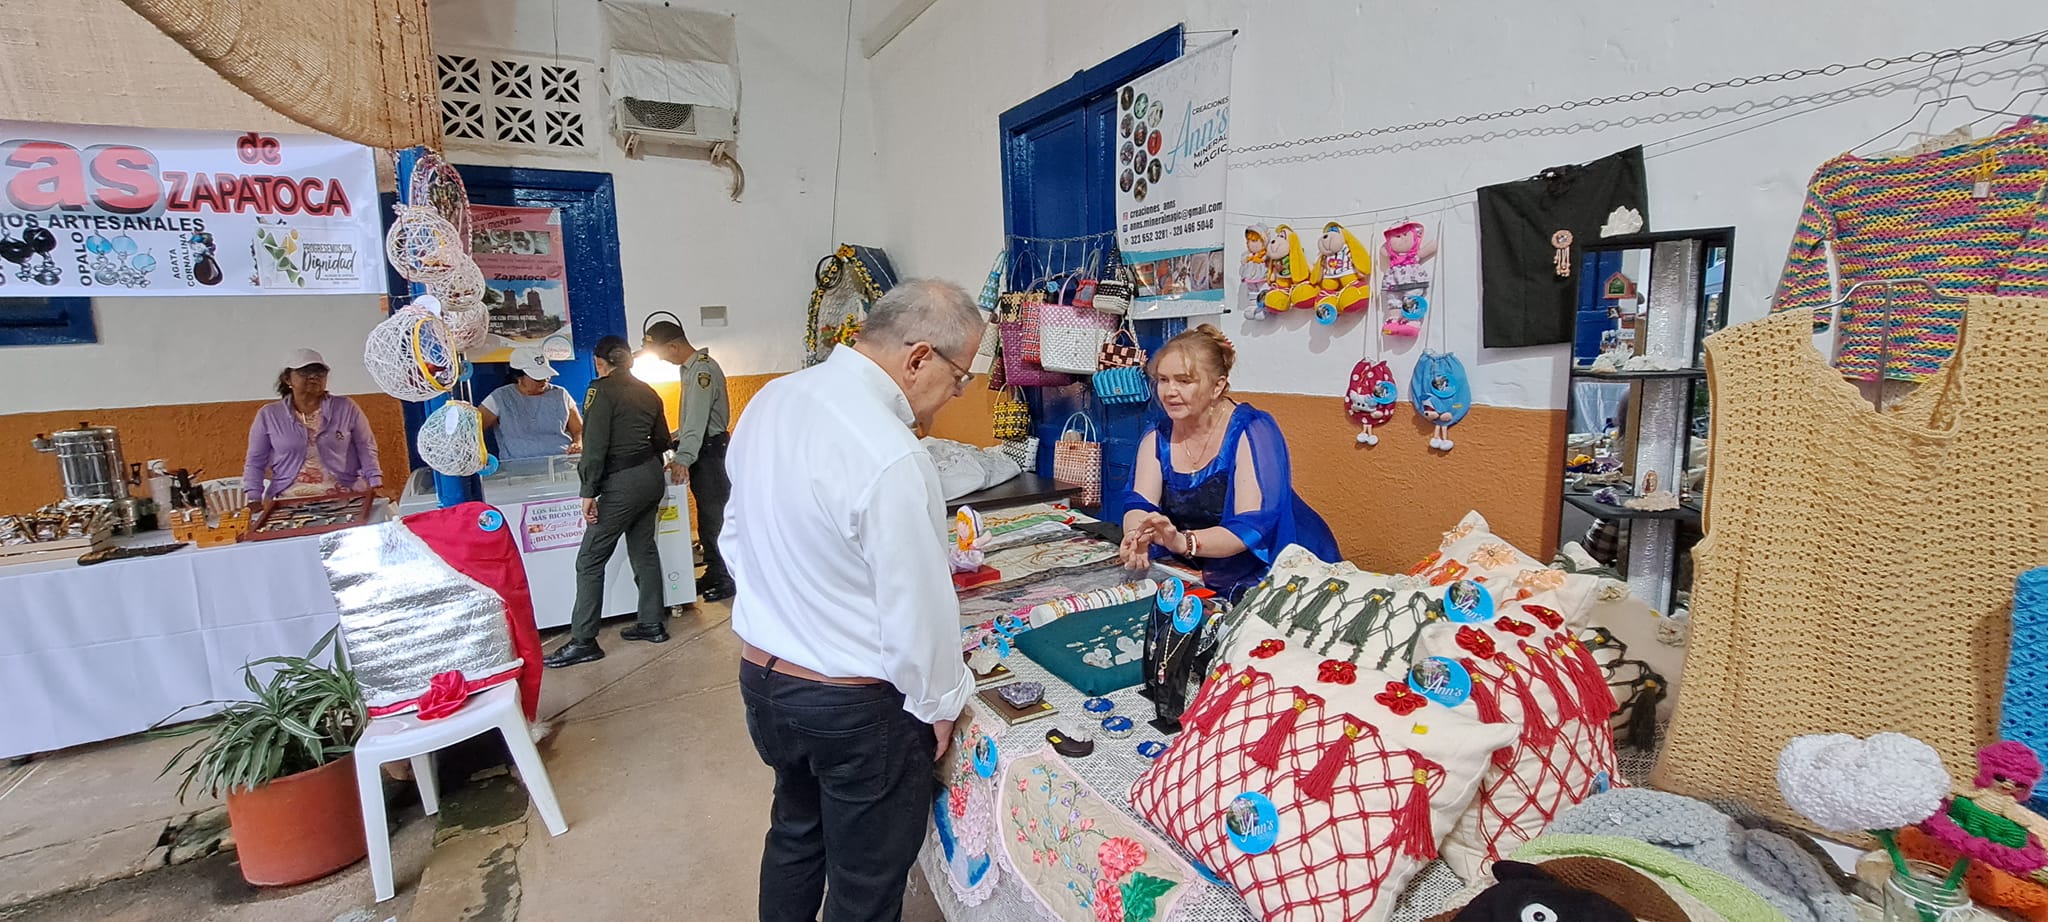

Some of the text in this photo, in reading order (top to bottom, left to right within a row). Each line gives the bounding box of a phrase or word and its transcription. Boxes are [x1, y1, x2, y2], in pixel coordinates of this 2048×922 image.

[1192, 96, 1229, 115] CREACIONES
[236, 132, 282, 165] de
[1164, 100, 1229, 174] Ann's
[1193, 134, 1227, 159] MINERAL
[1193, 144, 1227, 169] MAGIC
[2, 139, 165, 213] as
[162, 172, 352, 216] ZAPATOCA
[48, 213, 205, 232] ARTESANALES
[71, 231, 92, 286] OPALO
[169, 249, 181, 279] AGATA
[179, 233, 195, 287] CORNALINA
[302, 251, 357, 280] Dignidad
[494, 272, 547, 282] Zapatoca
[1422, 676, 1464, 697] Ann's
[1240, 812, 1274, 843] Ann's
